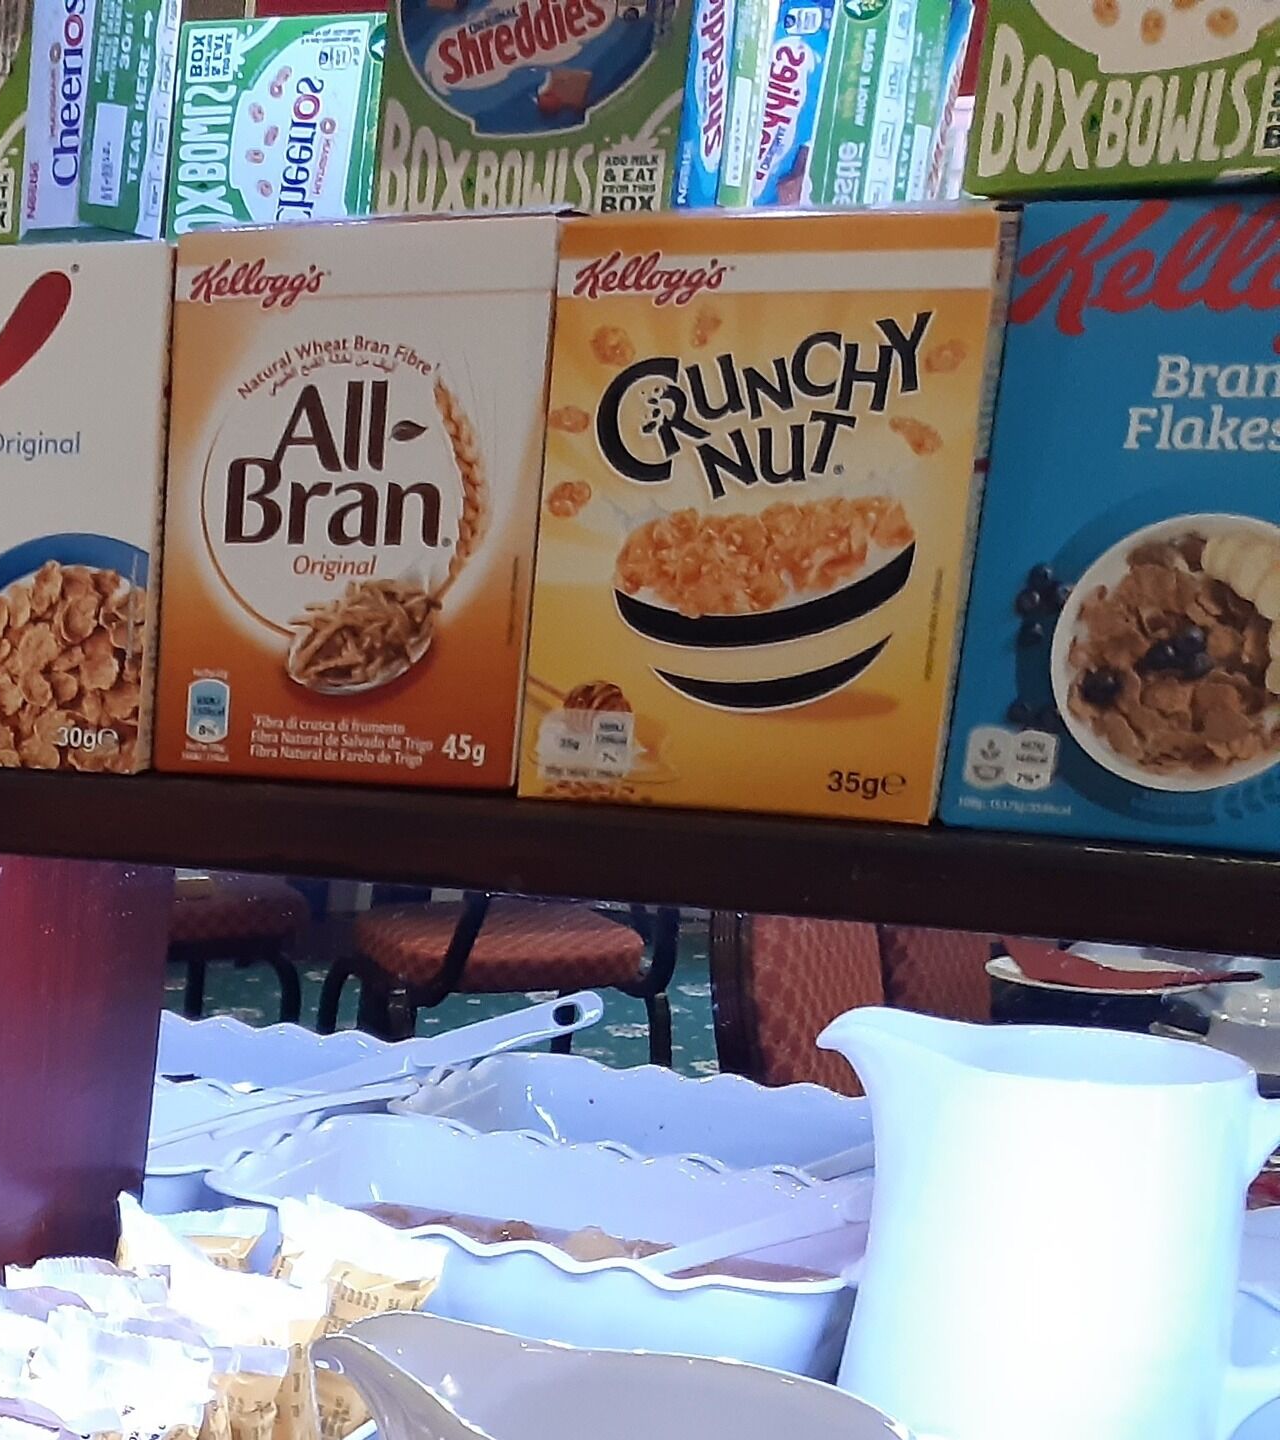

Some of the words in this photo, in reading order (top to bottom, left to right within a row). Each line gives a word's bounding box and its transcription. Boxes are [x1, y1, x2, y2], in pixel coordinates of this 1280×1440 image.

[439, 0, 606, 85] Shreddies
[135, 44, 151, 110] HERE
[978, 24, 1099, 177] BOX
[1096, 59, 1262, 168] BOWLS
[127, 121, 144, 184] TEAR
[377, 97, 471, 212] BOX
[474, 144, 594, 210] BOWLS
[603, 169, 616, 182] &
[622, 168, 656, 182] EAT
[600, 196, 654, 213] BOX
[190, 258, 324, 309] Kellogg's
[574, 250, 725, 306] Kellogg's
[237, 351, 292, 399] Natural
[294, 338, 347, 361] Wheat
[354, 335, 390, 355] Bran
[394, 344, 432, 376] Fibre
[596, 311, 933, 484] CRUNCHY
[696, 411, 856, 500] NUT
[225, 456, 441, 548] Bran
[293, 555, 376, 581] Original
[251, 730, 279, 743] Fibra
[281, 732, 323, 746] Natural
[325, 732, 339, 746] de
[341, 733, 385, 749] Salvado
[387, 735, 401, 750] de
[404, 737, 433, 754] Trigo
[286, 715, 298, 729] di
[300, 719, 335, 731] crusca
[337, 717, 349, 731] di
[351, 718, 405, 734] frumento
[442, 734, 486, 766] 45g
[250, 744, 278, 758] Fibra
[280, 745, 322, 760] Natural
[324, 747, 338, 761] de
[340, 749, 375, 764] Farelo
[377, 750, 391, 764] de
[394, 752, 423, 769] Trigo
